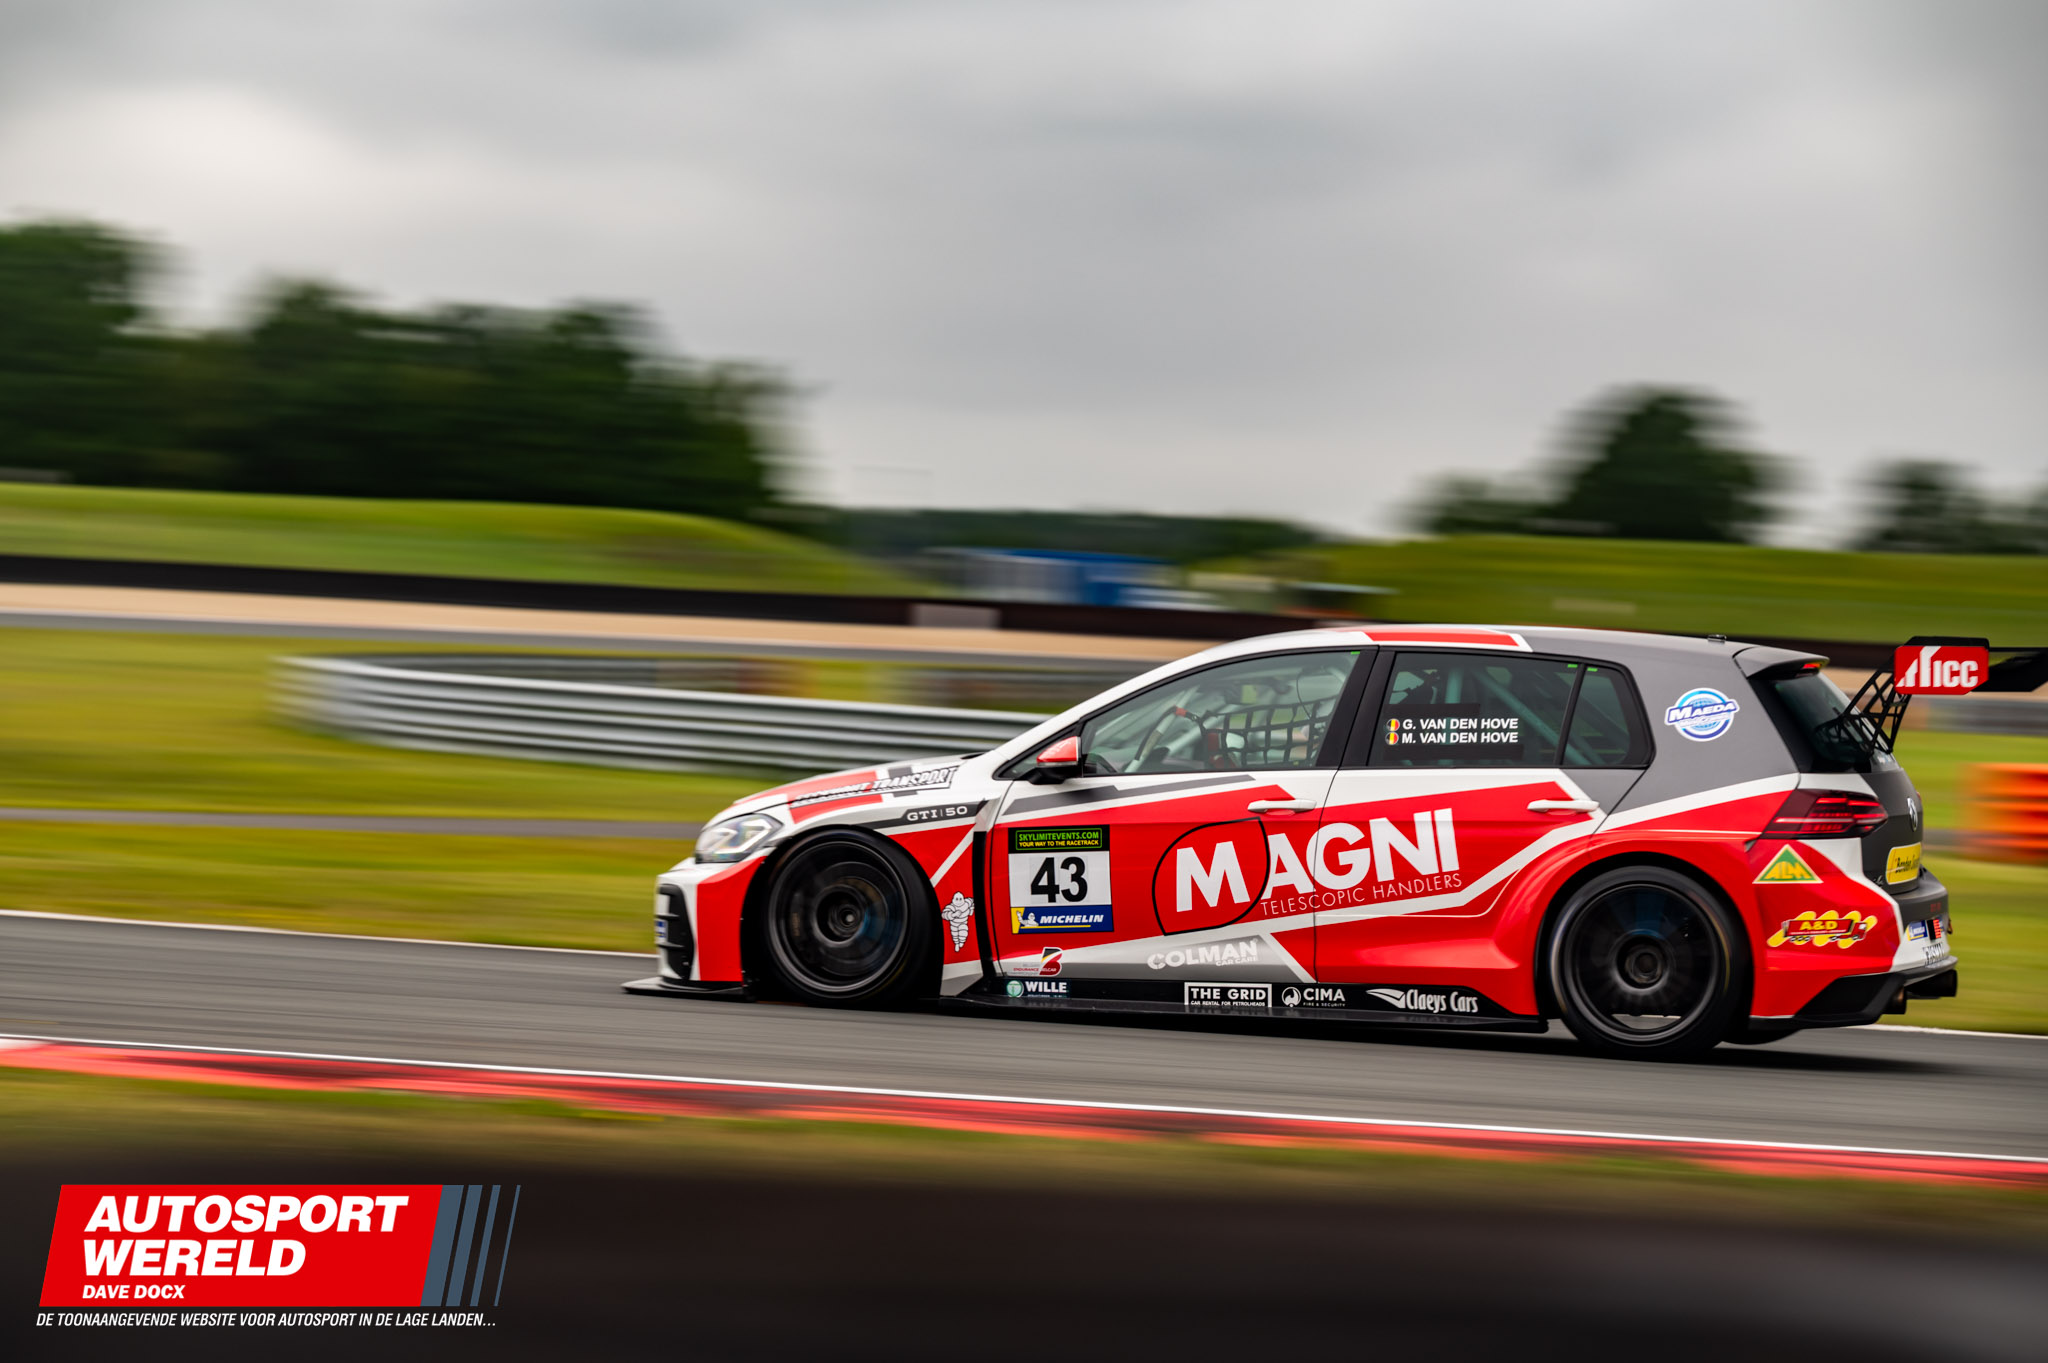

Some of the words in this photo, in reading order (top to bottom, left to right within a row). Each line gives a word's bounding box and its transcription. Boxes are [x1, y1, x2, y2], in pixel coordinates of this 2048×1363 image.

[1668, 702, 1737, 722] MAEDA
[1402, 719, 1417, 730] G.
[1419, 719, 1447, 730] VAN
[1450, 719, 1478, 729] DEN
[1480, 718, 1519, 729] HOVE
[1401, 733, 1417, 744] M.
[1419, 733, 1447, 744] VAN
[1450, 732, 1478, 743] DEN
[1480, 732, 1519, 743] HOVE
[906, 808, 938, 822] GTI
[945, 805, 968, 817] 50
[1018, 831, 1099, 842] SKYLIMITEVENTS.COM
[1175, 807, 1460, 913] MAGNI
[1030, 856, 1089, 904] 43
[1260, 887, 1366, 916] TELESCOPIC
[1372, 873, 1463, 900] HANDLERS
[1039, 914, 1104, 924] MICHELIN
[1799, 920, 1838, 931] A&D
[1147, 940, 1258, 970] COLMAN
[1215, 958, 1234, 967] CAR
[1025, 981, 1068, 993] WILLE
[1190, 987, 1221, 1000] THE
[1227, 988, 1267, 1000] GRID
[1302, 987, 1346, 1002] CIMA
[1405, 988, 1447, 1014] Claeys
[1449, 991, 1479, 1013] Cars
